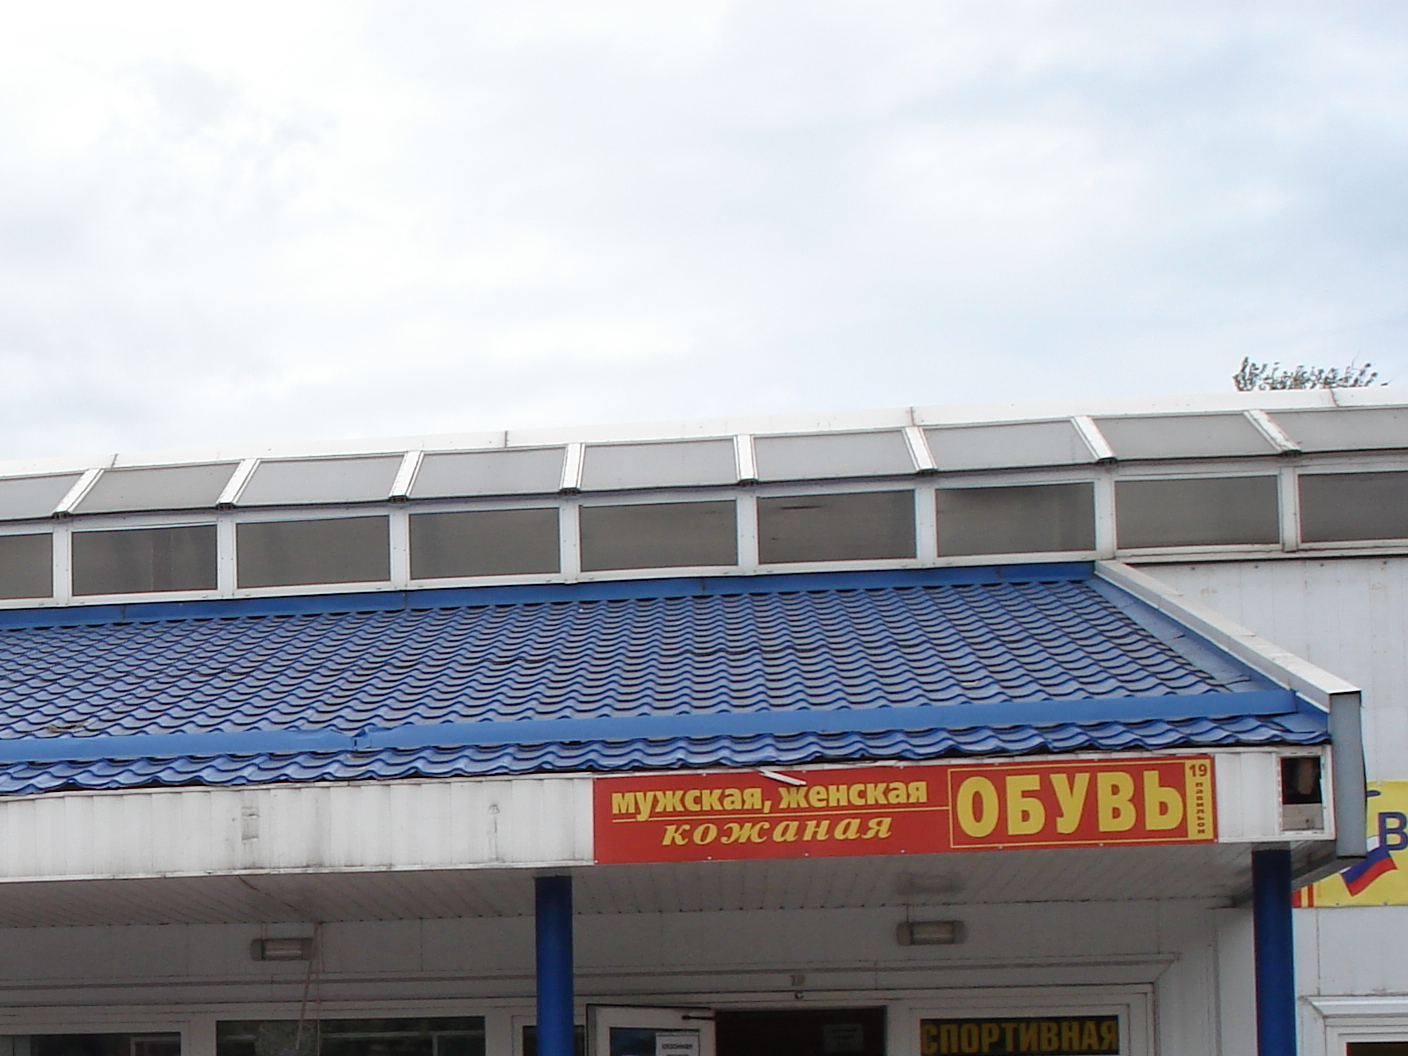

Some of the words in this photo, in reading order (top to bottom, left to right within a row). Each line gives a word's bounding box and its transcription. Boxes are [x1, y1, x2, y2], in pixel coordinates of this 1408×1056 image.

[1189, 763, 1207, 777] 19
[610, 785, 772, 822] мужская,
[777, 780, 928, 811] женская
[955, 769, 1185, 839] ОБУВЬ
[661, 813, 893, 846] кожаная
[921, 1020, 1118, 1055] СПОРТИВНАЯ
